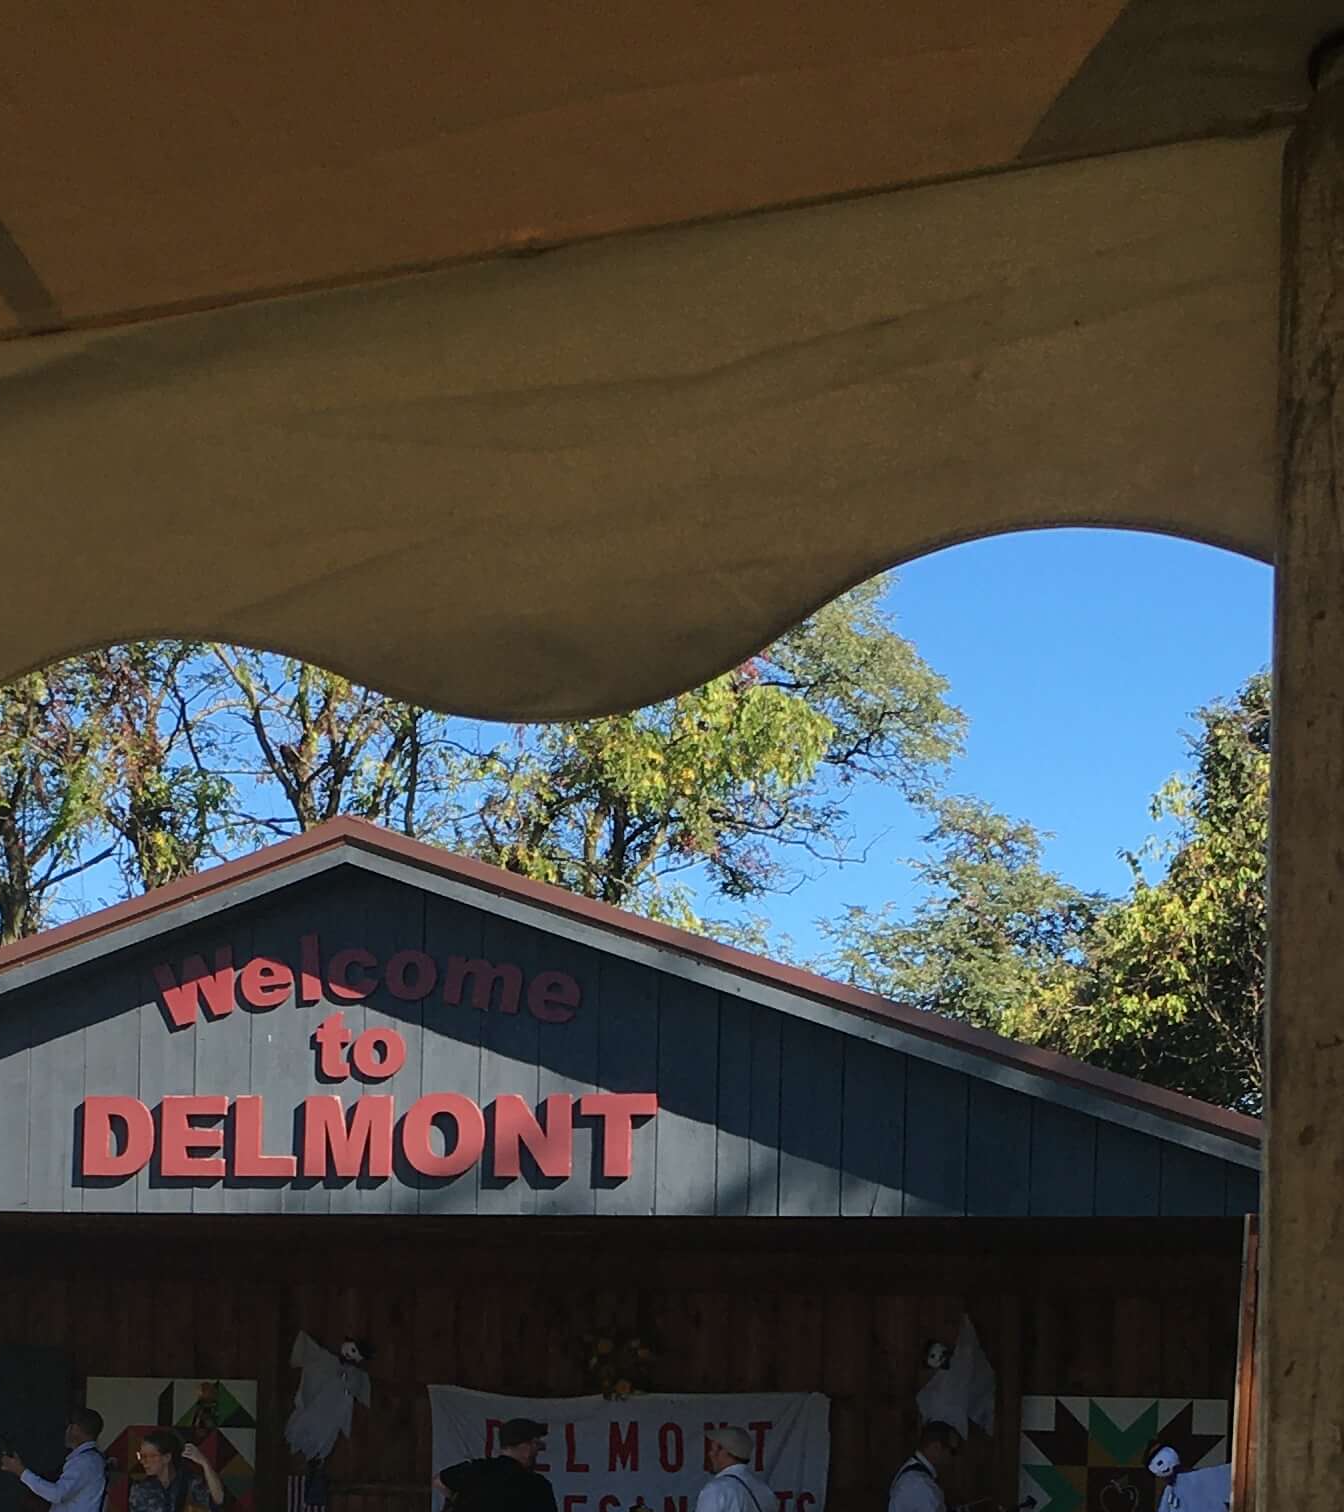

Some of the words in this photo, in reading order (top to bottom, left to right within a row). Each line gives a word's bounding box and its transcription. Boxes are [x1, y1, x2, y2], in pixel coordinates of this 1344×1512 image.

[157, 934, 582, 1027] Welcome
[315, 1010, 407, 1081] to
[81, 1091, 658, 1179] DELMONT
